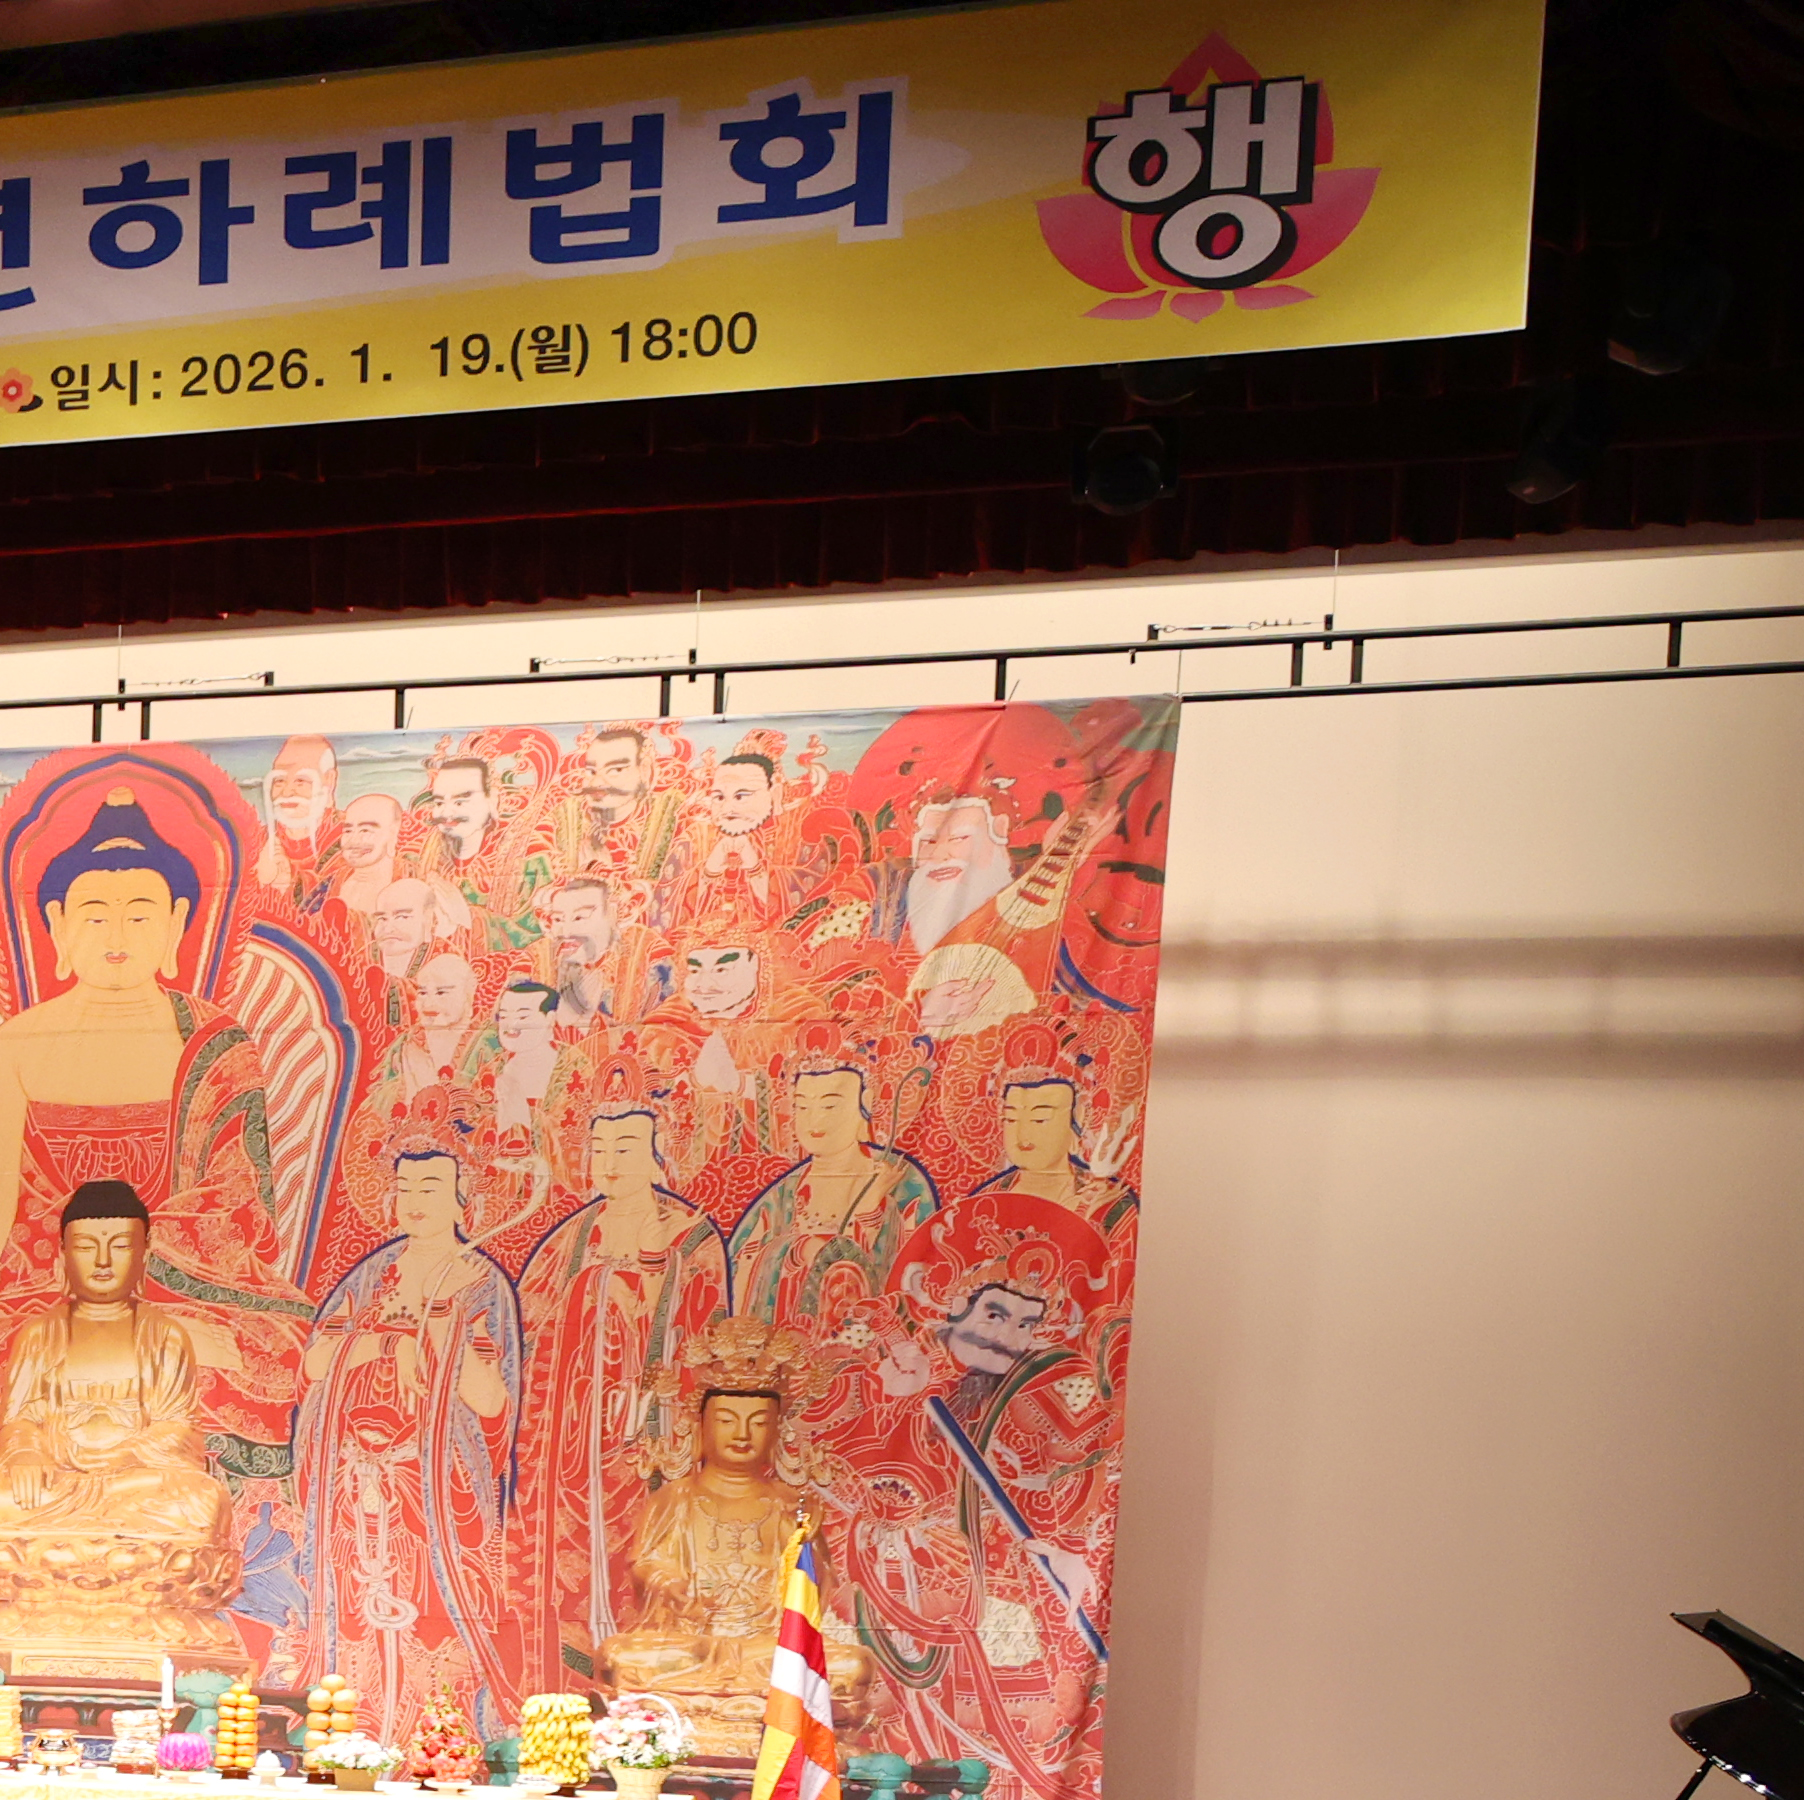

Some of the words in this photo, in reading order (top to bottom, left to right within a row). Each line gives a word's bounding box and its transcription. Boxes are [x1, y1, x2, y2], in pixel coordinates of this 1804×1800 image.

[1087, 75, 1319, 290] 행
[180, 346, 325, 398] 2026.
[349, 342, 393, 385] 1.
[610, 310, 759, 364] 18:00
